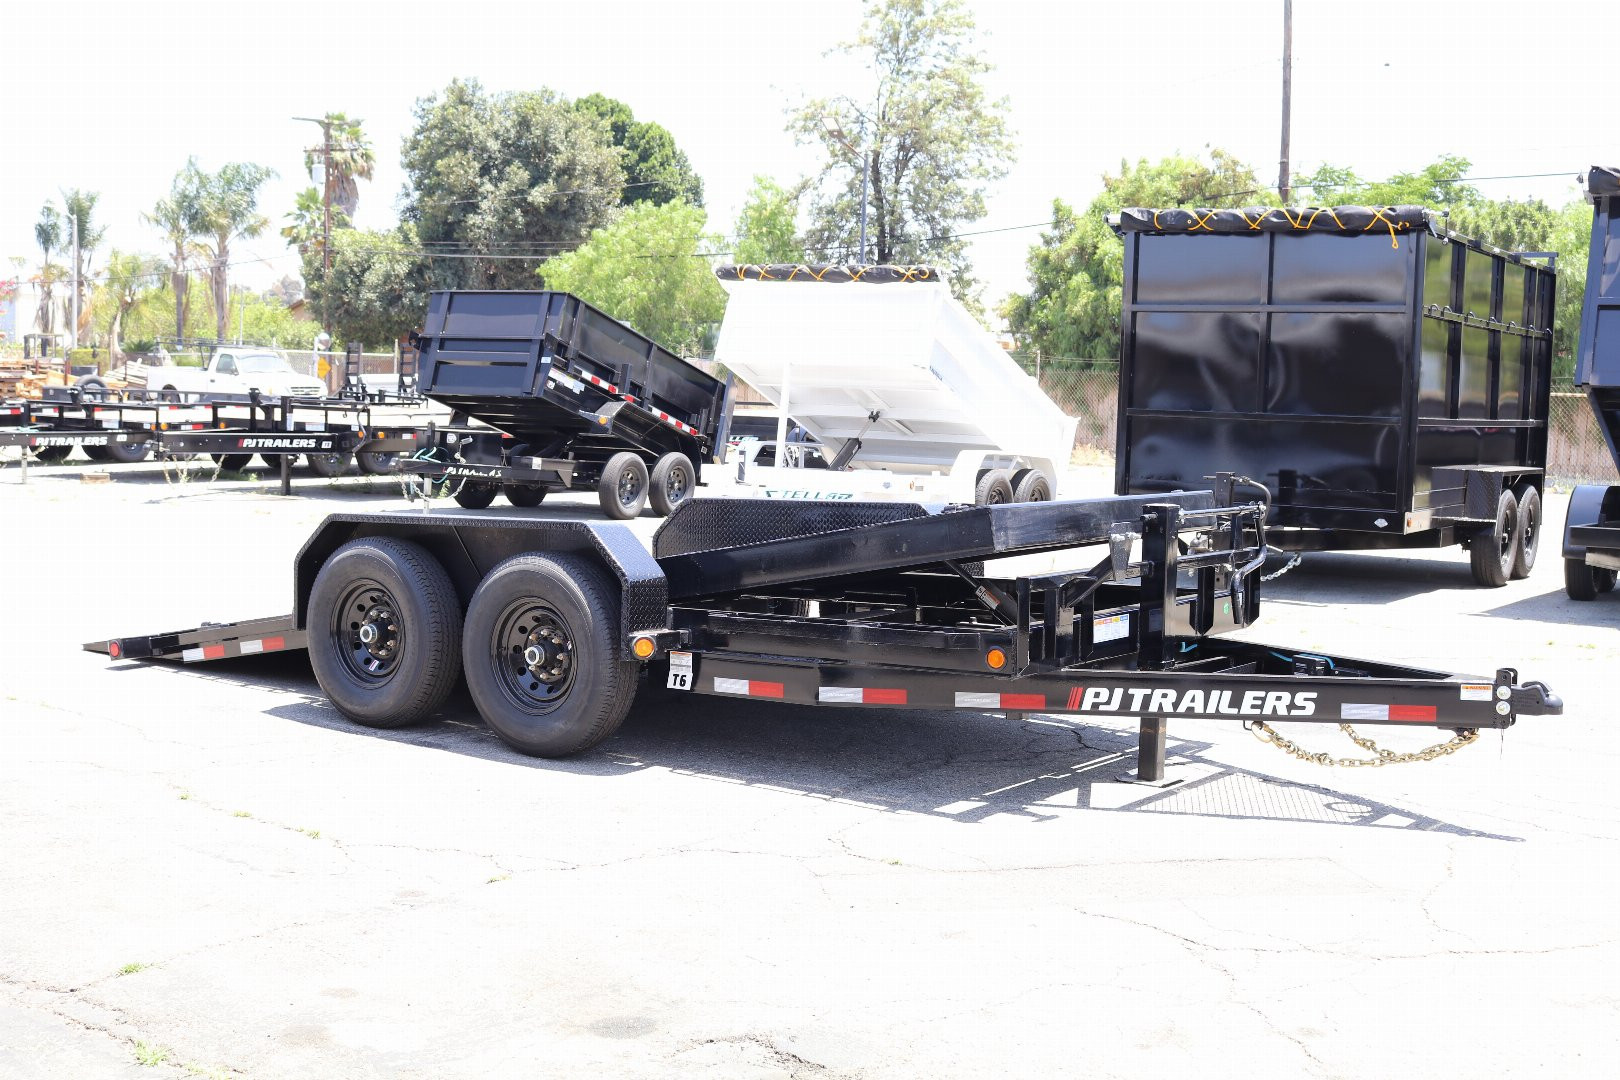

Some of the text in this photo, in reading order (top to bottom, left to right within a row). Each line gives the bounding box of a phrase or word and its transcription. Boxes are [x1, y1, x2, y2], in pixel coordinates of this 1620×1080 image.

[50, 437, 108, 446] TRAILERS
[242, 439, 256, 448] PJ
[257, 439, 316, 448] TRAILERS
[672, 673, 687, 687] T6
[1081, 687, 1318, 716] PJ TRAILERS
